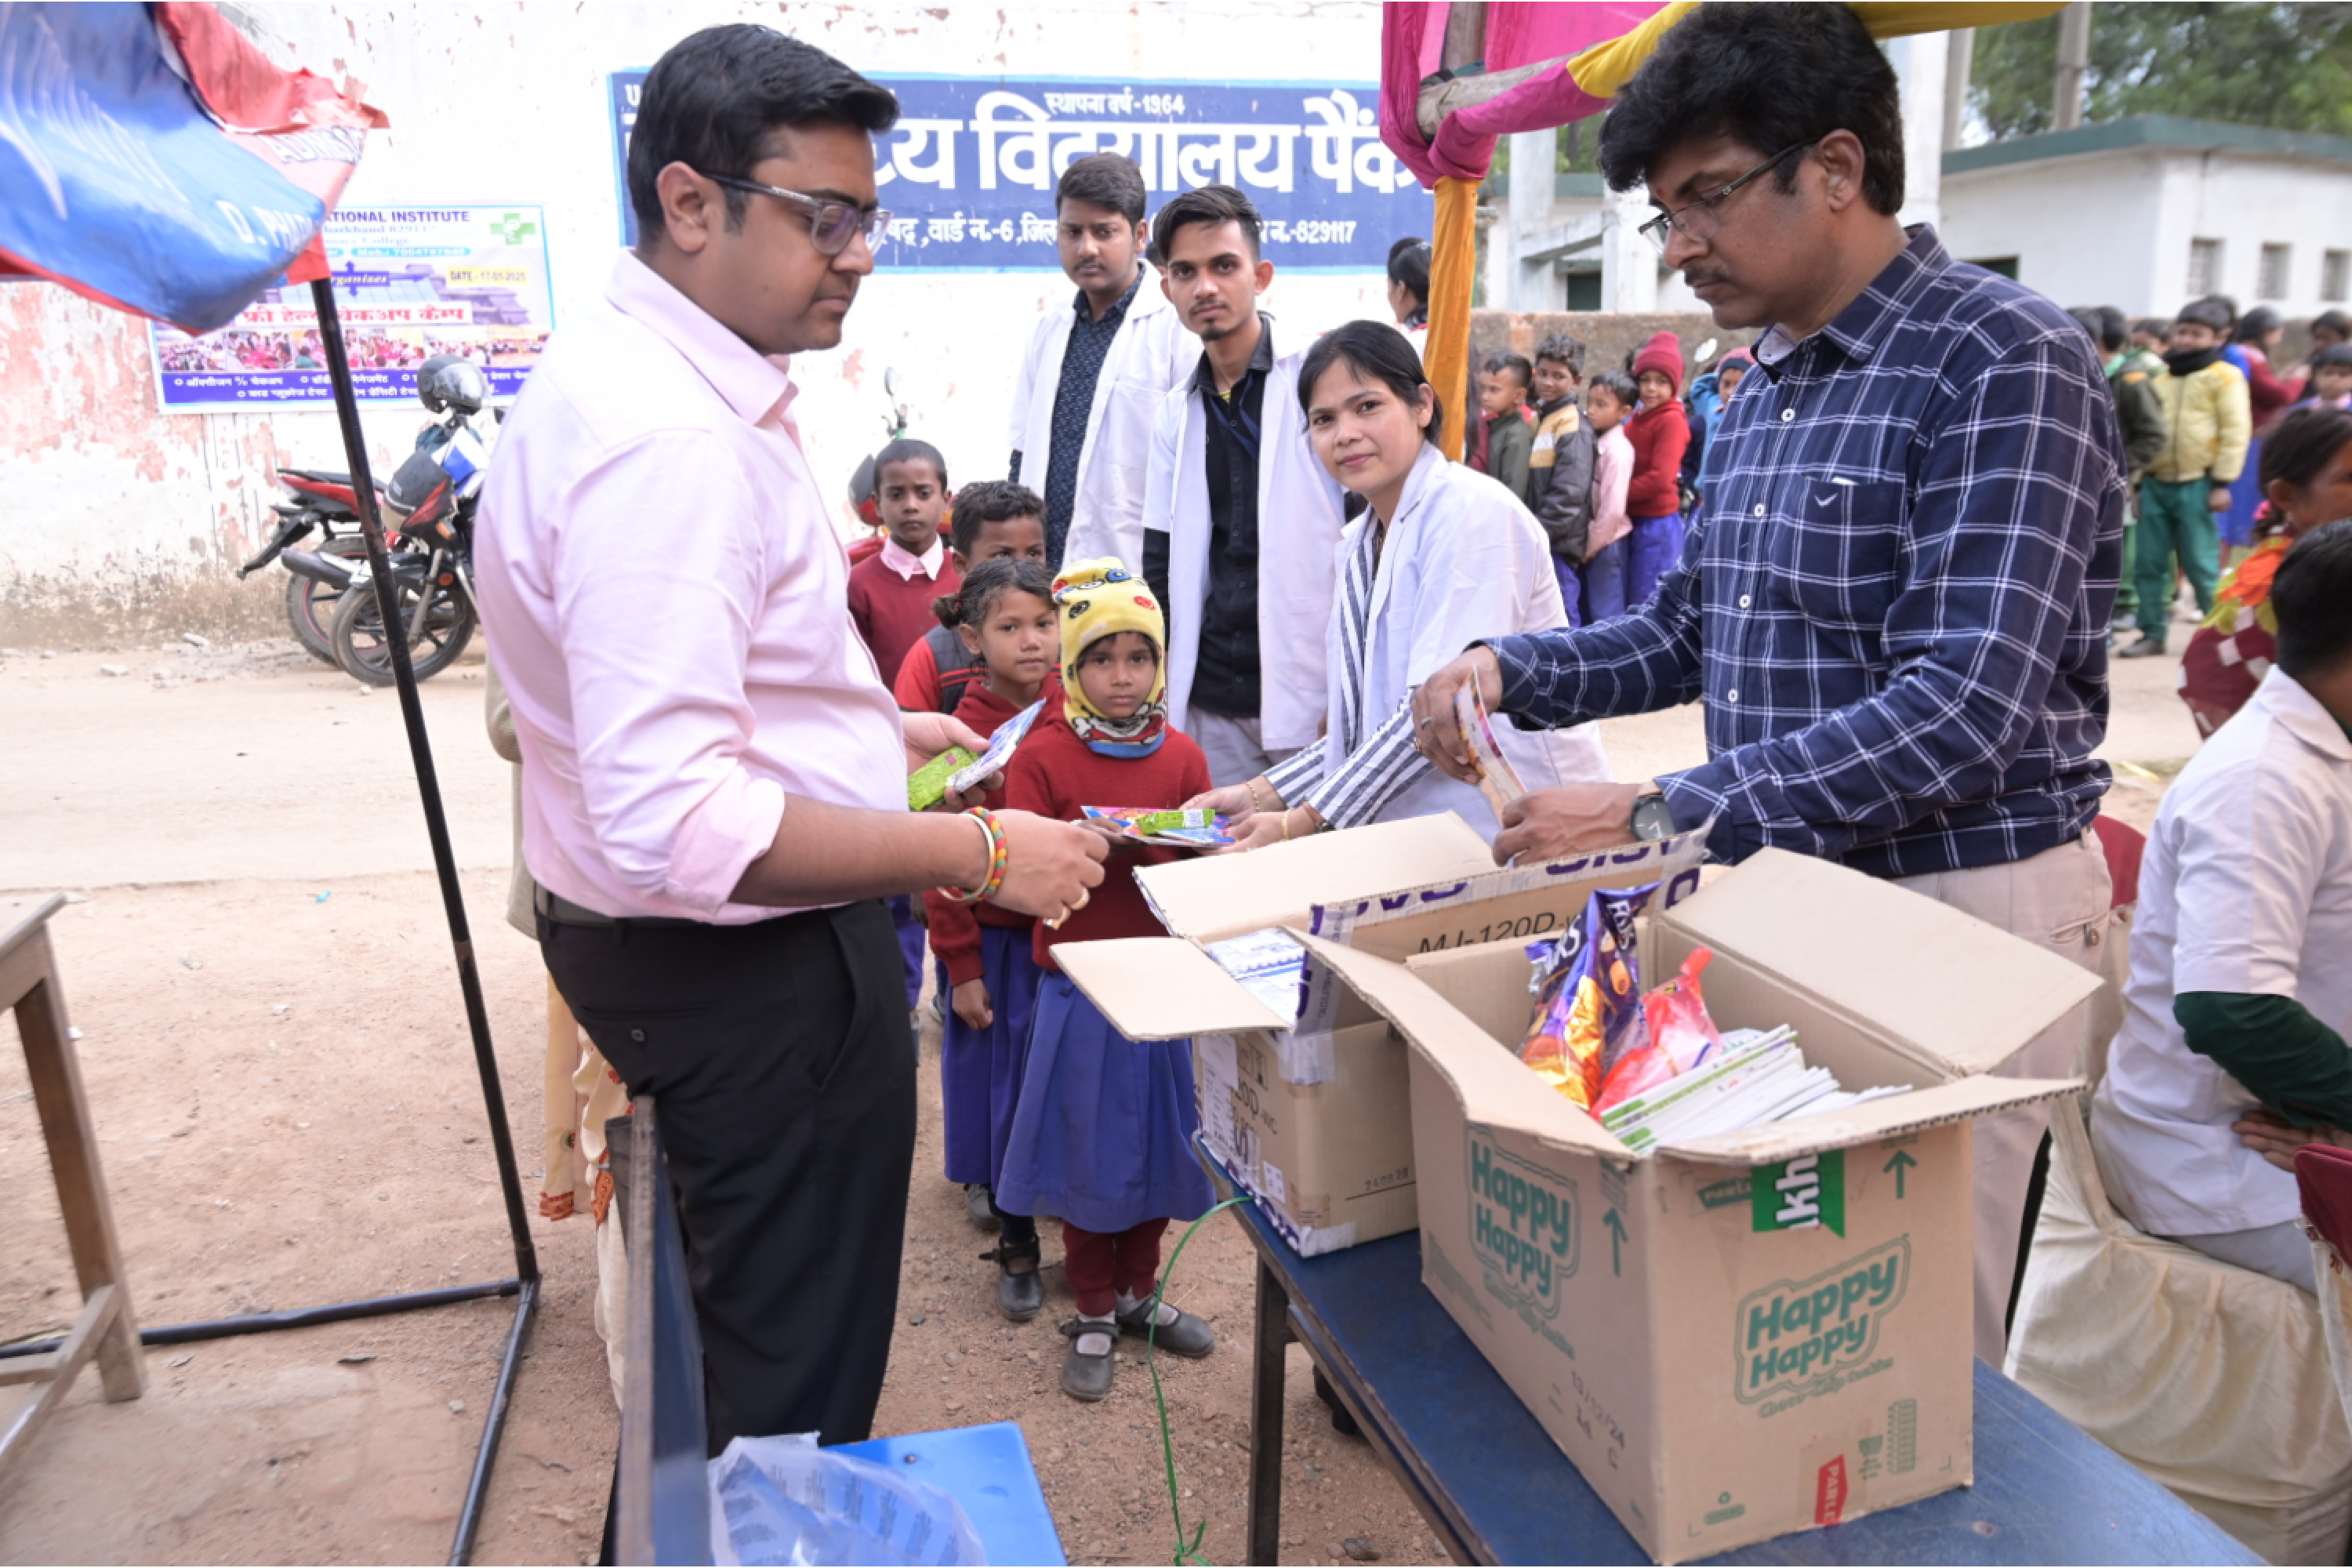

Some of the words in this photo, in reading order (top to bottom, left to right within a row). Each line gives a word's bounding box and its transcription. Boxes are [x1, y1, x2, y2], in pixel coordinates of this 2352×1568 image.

[1302, 89, 1434, 194] पैंक
[324, 225, 385, 234] harkhand
[390, 211, 470, 223] INSTITUTE
[1471, 1139, 1571, 1258] Happy
[1475, 1202, 1552, 1298] Happy
[1747, 1254, 1898, 1351] Happy
[1749, 1313, 1869, 1388] Happy
[1824, 1465, 1839, 1519] PARLE
